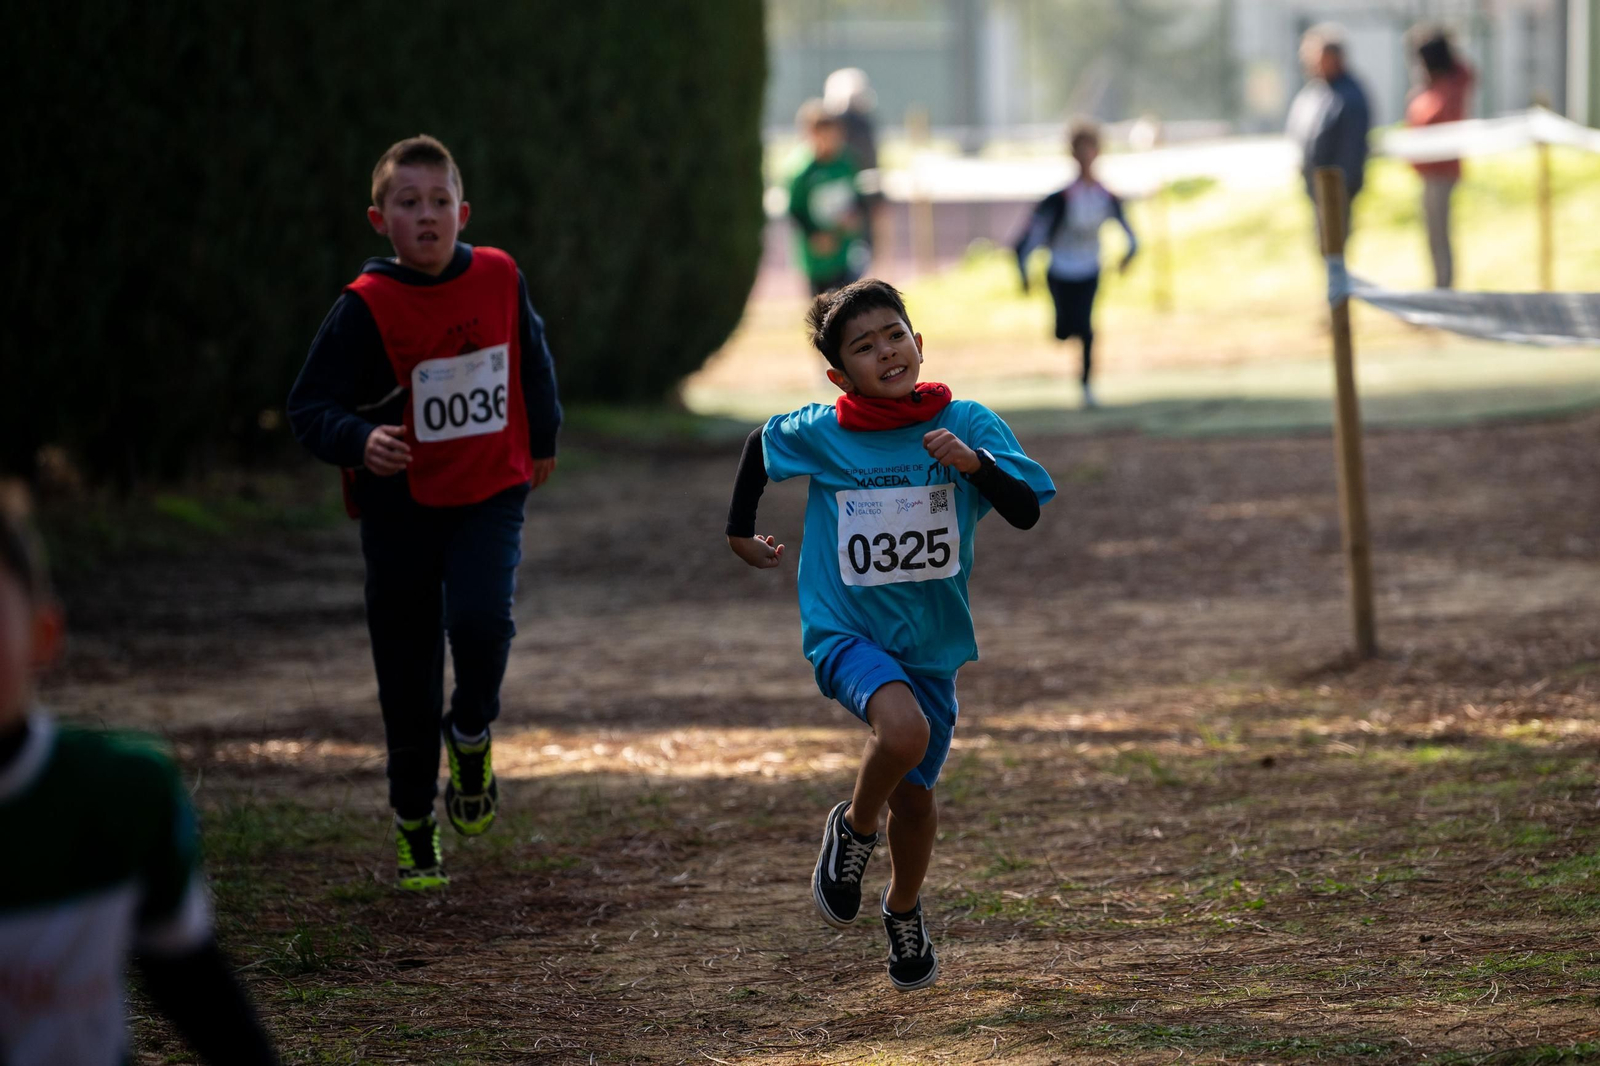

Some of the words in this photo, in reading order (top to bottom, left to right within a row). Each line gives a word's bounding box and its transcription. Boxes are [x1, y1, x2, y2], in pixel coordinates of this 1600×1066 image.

[859, 463, 911, 475] PLURILINGÜE
[913, 463, 924, 471] DE
[855, 475, 911, 488] MACEDA
[847, 527, 951, 575] 0325
